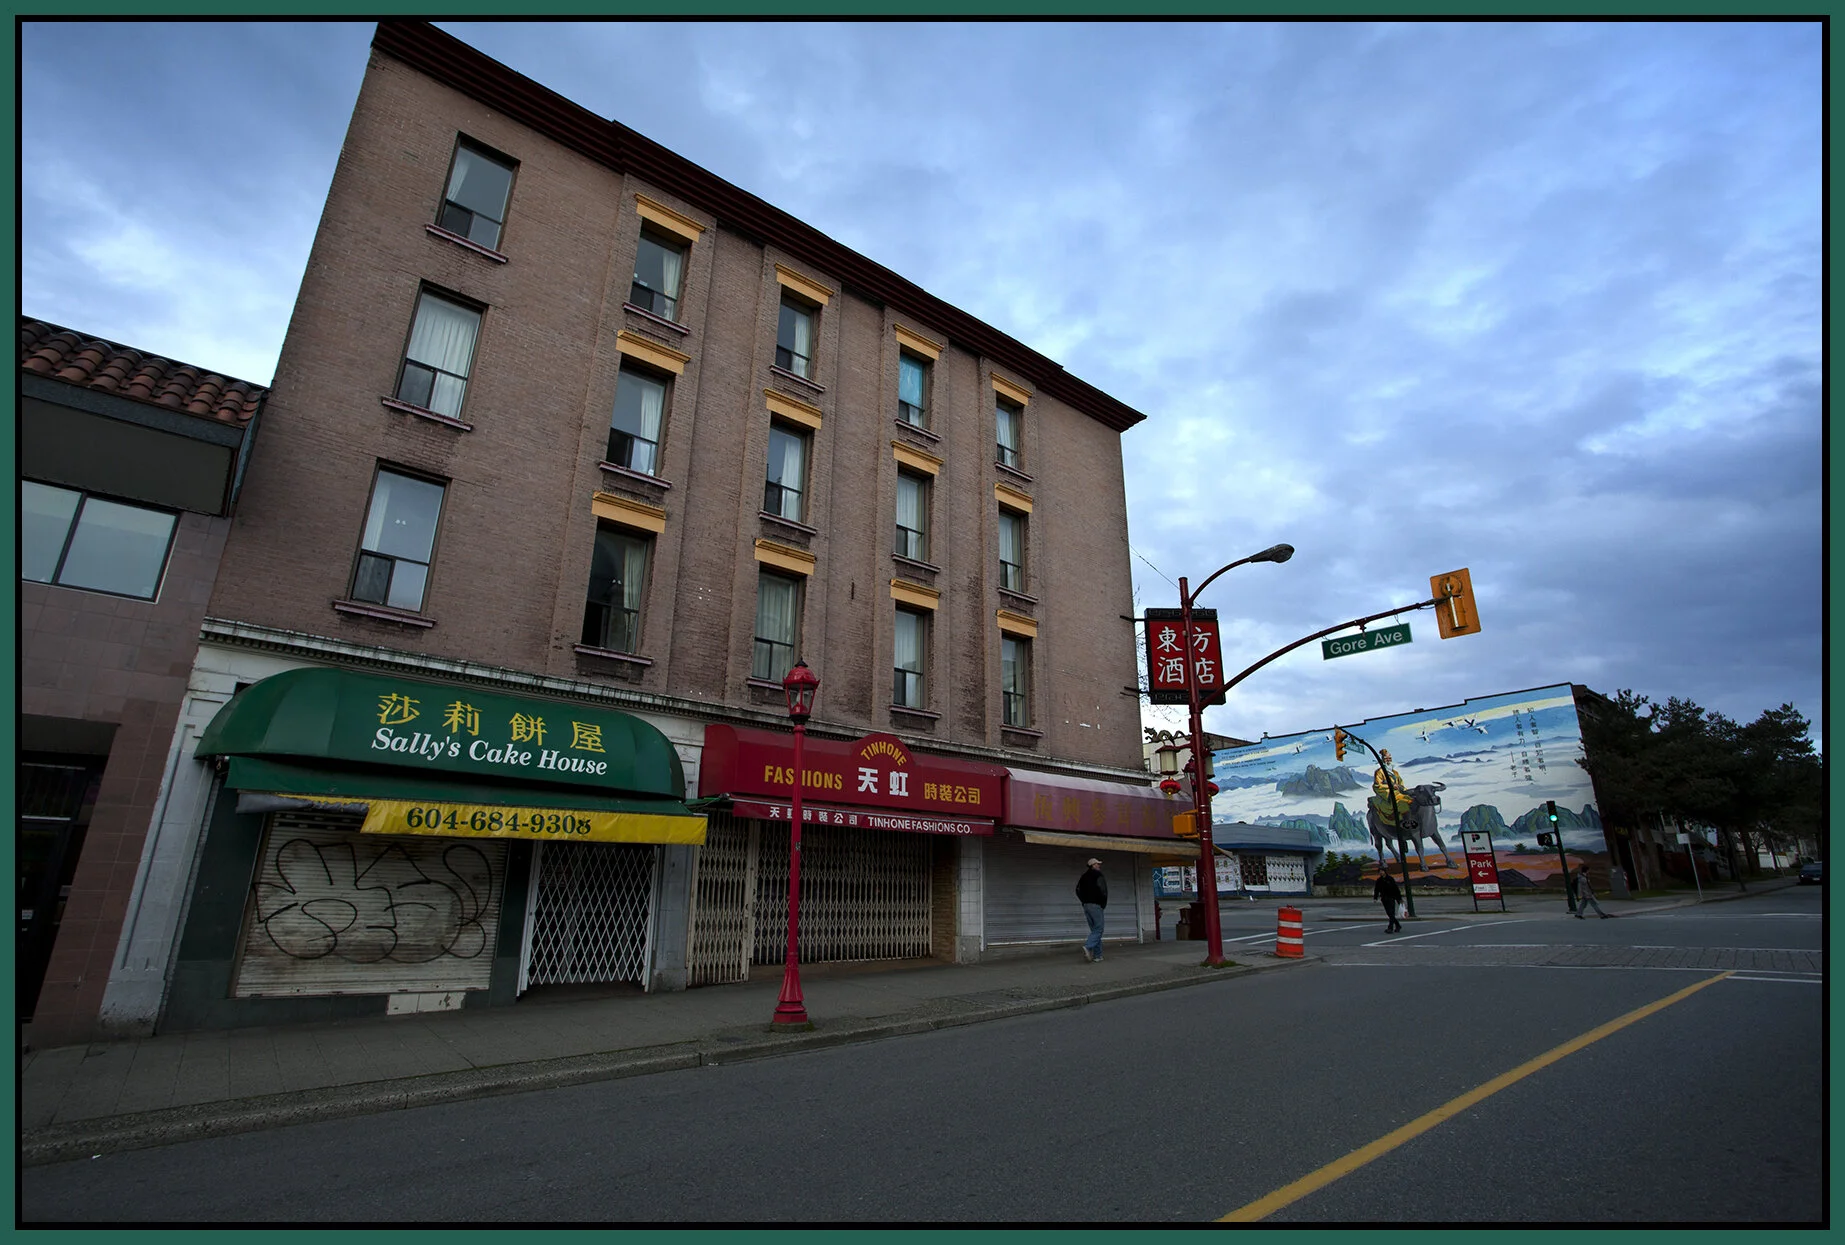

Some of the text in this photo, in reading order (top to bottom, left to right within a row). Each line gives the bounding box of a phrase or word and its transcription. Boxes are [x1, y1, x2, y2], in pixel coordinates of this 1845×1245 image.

[1156, 625, 1213, 653] 東方
[1329, 631, 1403, 655] Gore Ave
[1157, 656, 1215, 684] 酒店
[377, 692, 606, 753] 莎莉餅屋
[371, 727, 608, 775] Sally's Cake House
[860, 741, 907, 766] TINHONE
[857, 767, 909, 797] 天虹
[924, 782, 981, 805] 時裝公司
[406, 806, 591, 835] 604-684-9308
[868, 816, 973, 834] TINHONE FASHIONS CO.
[1470, 860, 1493, 868] Park
